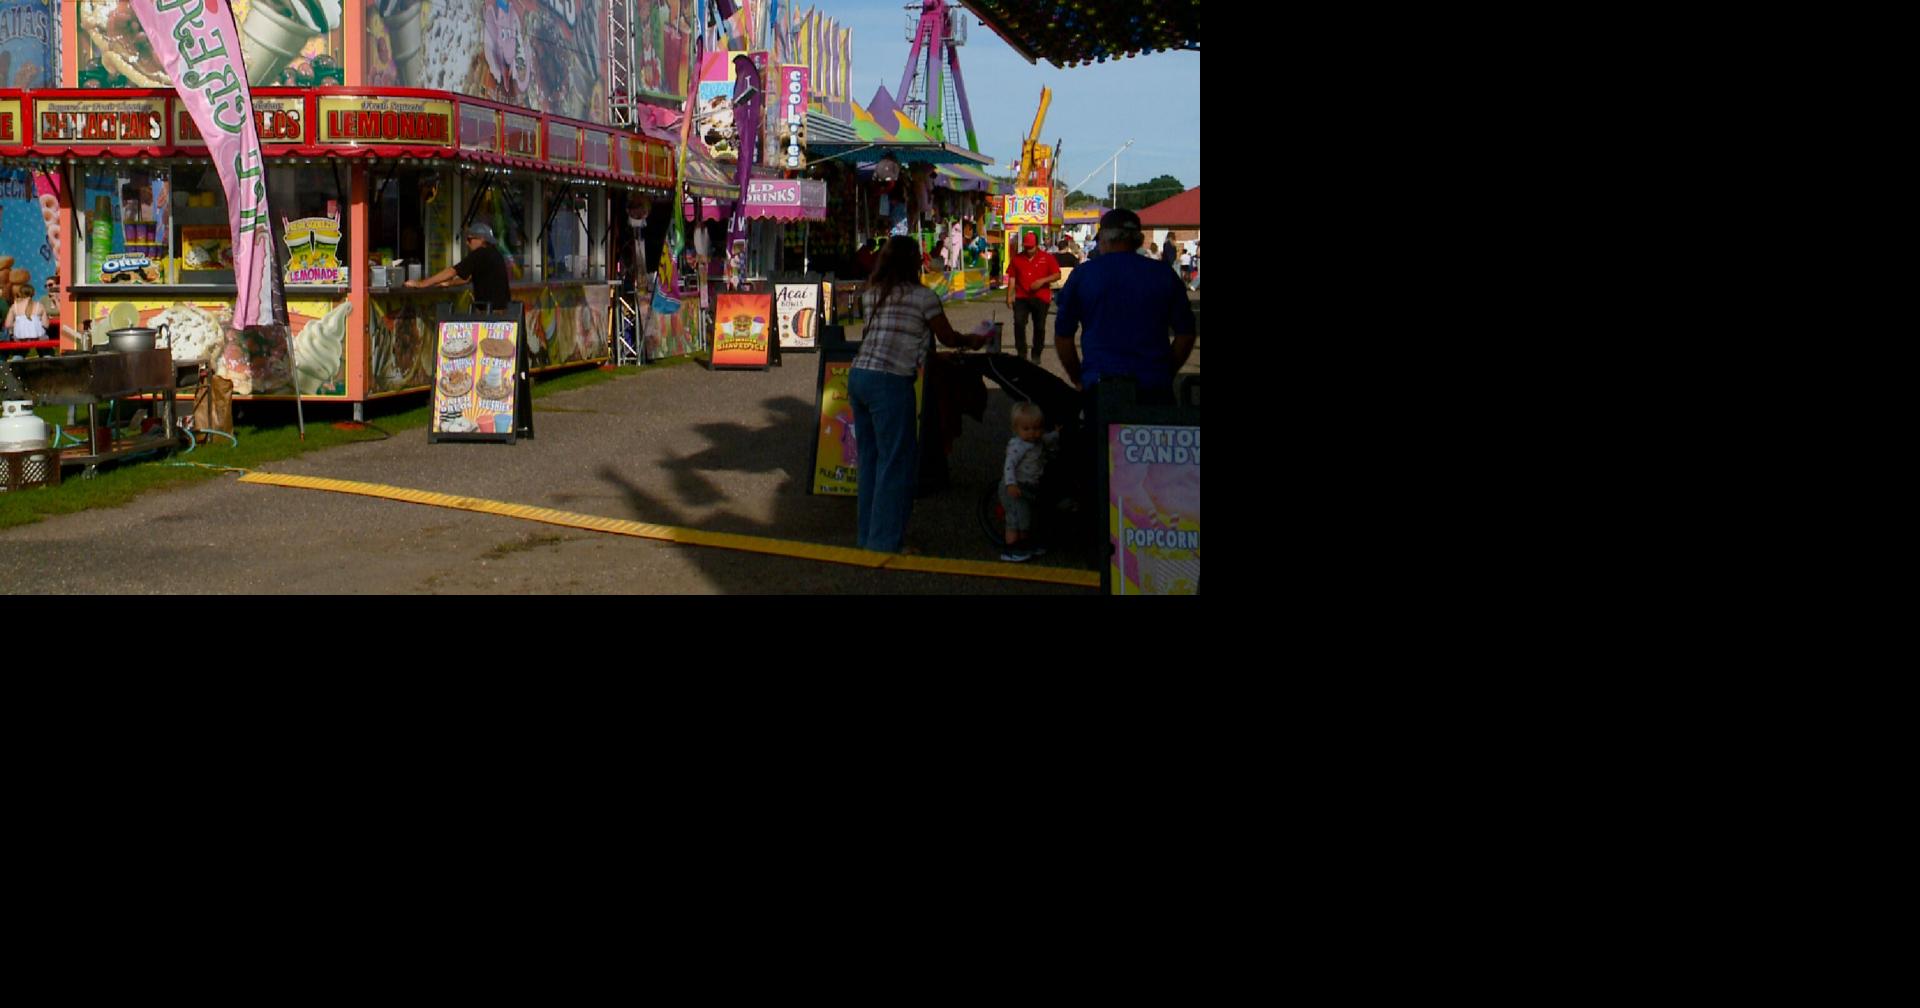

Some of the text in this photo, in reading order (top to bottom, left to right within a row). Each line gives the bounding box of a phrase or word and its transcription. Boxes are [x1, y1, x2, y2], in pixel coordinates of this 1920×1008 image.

[42, 112, 118, 139] ELEPHANT
[120, 111, 161, 140] EARS
[328, 110, 449, 142] LEMONADE
[1009, 195, 1047, 216] TICKETS
[291, 268, 338, 282] LEMONADE
[1125, 445, 1200, 464] CANDY
[1126, 529, 1199, 549] POPCORN
